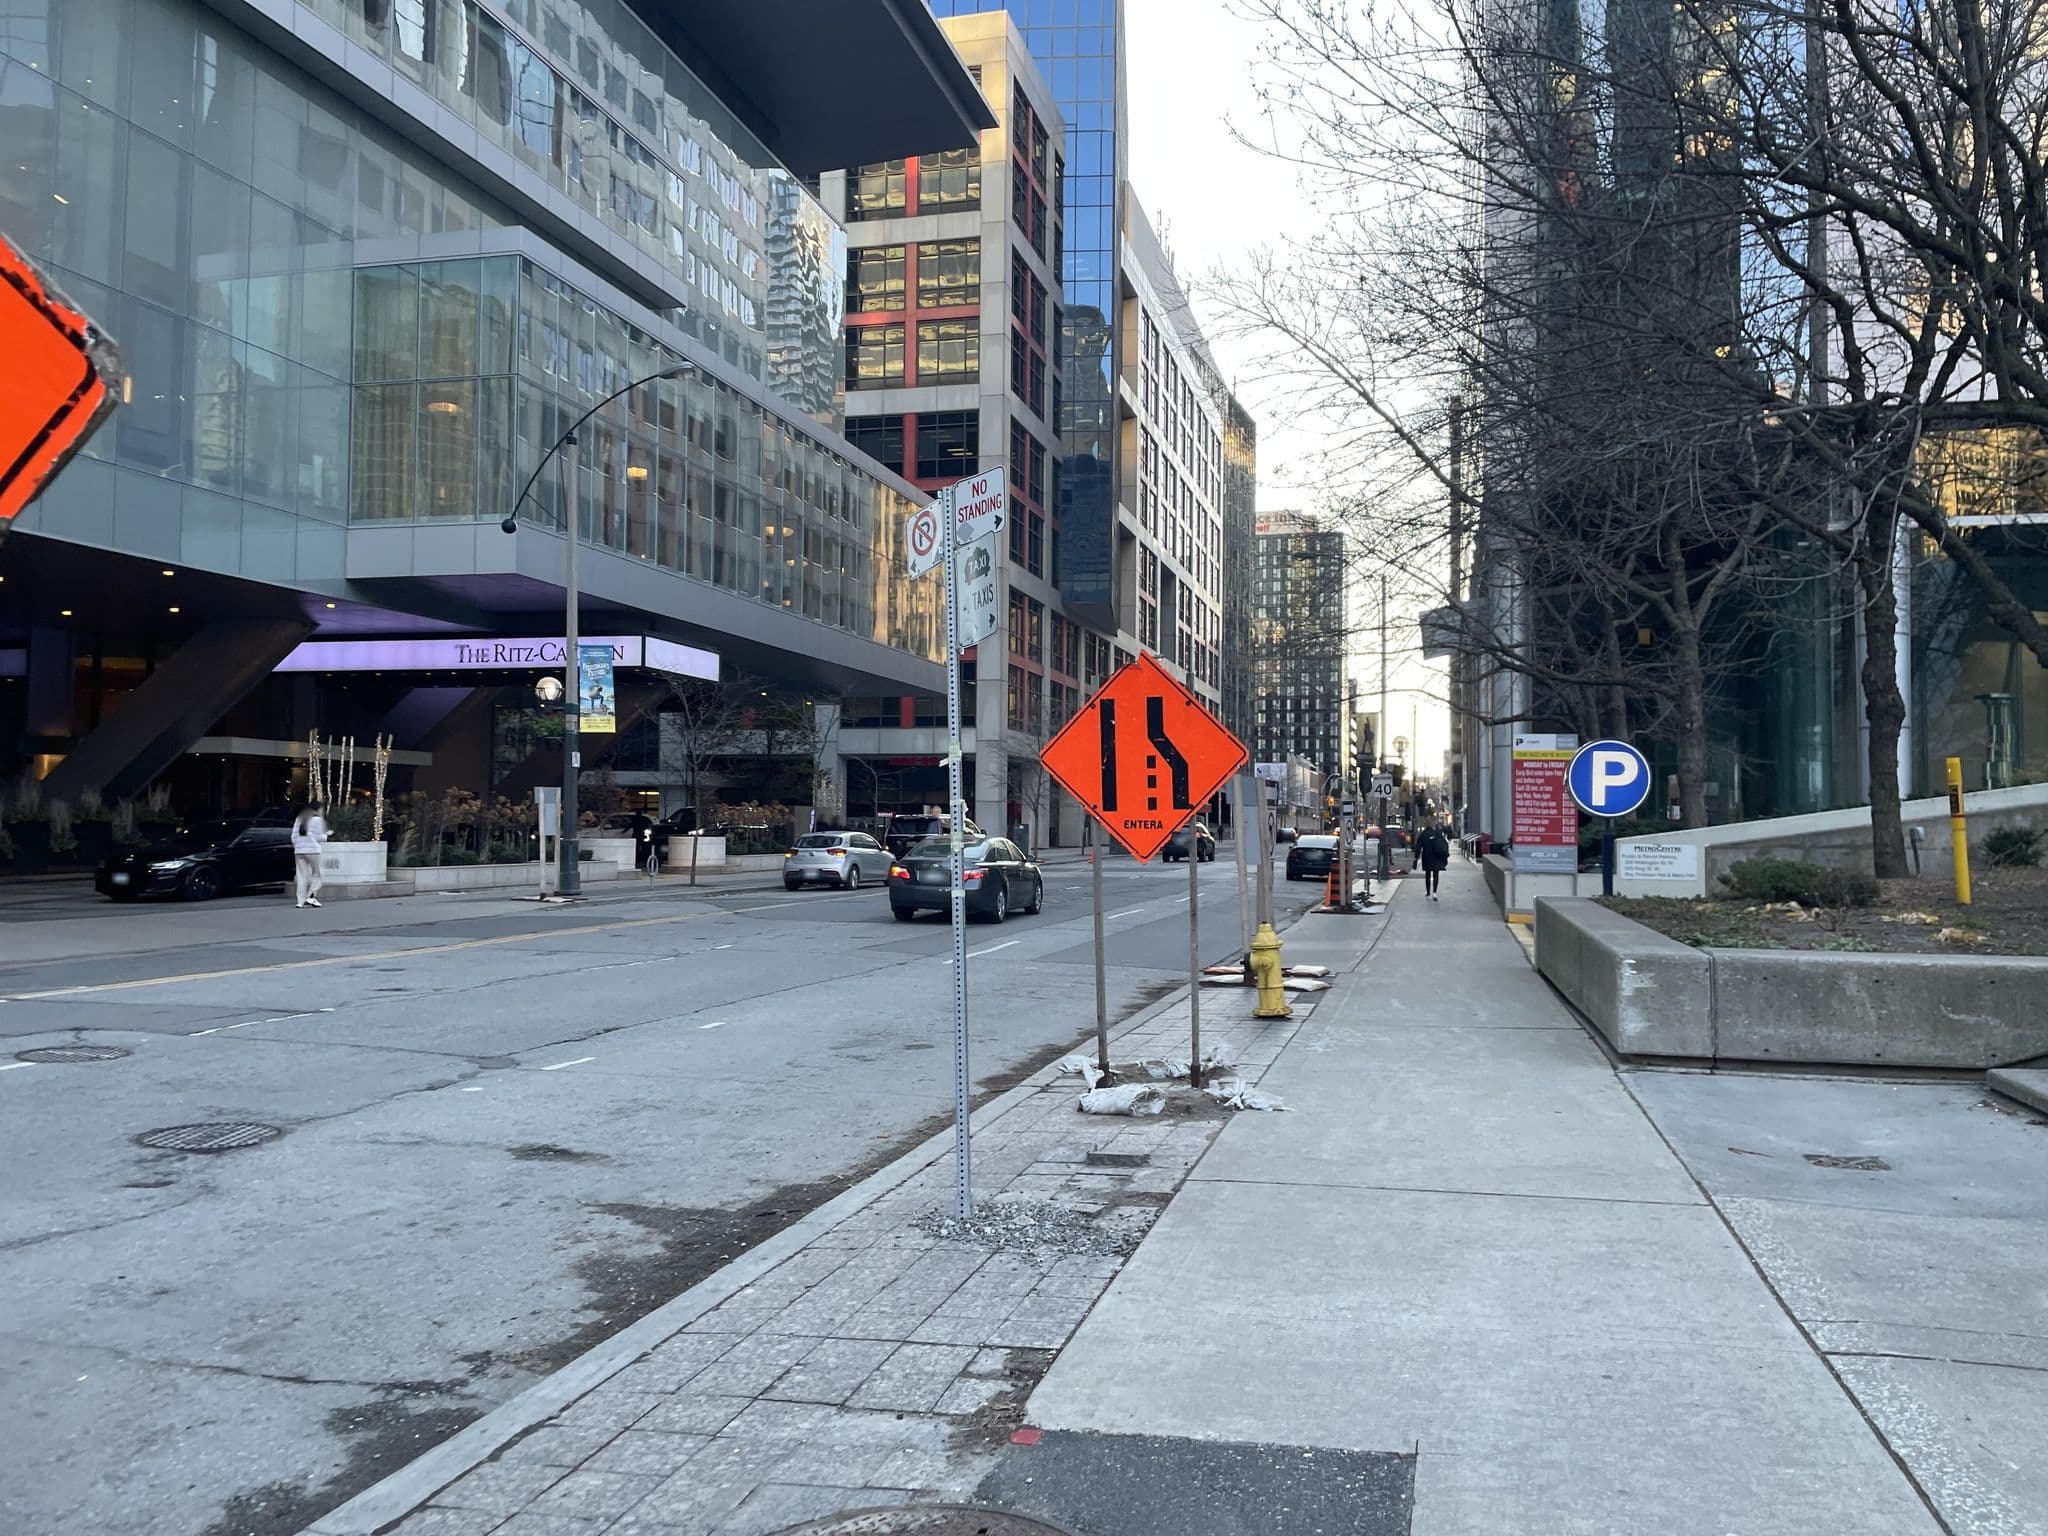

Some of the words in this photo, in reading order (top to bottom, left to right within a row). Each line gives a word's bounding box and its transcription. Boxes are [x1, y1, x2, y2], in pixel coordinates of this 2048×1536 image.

[972, 479, 987, 498] NO
[958, 494, 1002, 523] STANDING
[968, 554, 989, 573] TAXI
[972, 584, 994, 610] TAXIS
[455, 644, 490, 663] THE
[493, 642, 625, 663] RITZ-CAN
[1592, 750, 1639, 807] P
[1374, 783, 1392, 795] 40
[1124, 820, 1163, 829] ENTERA
